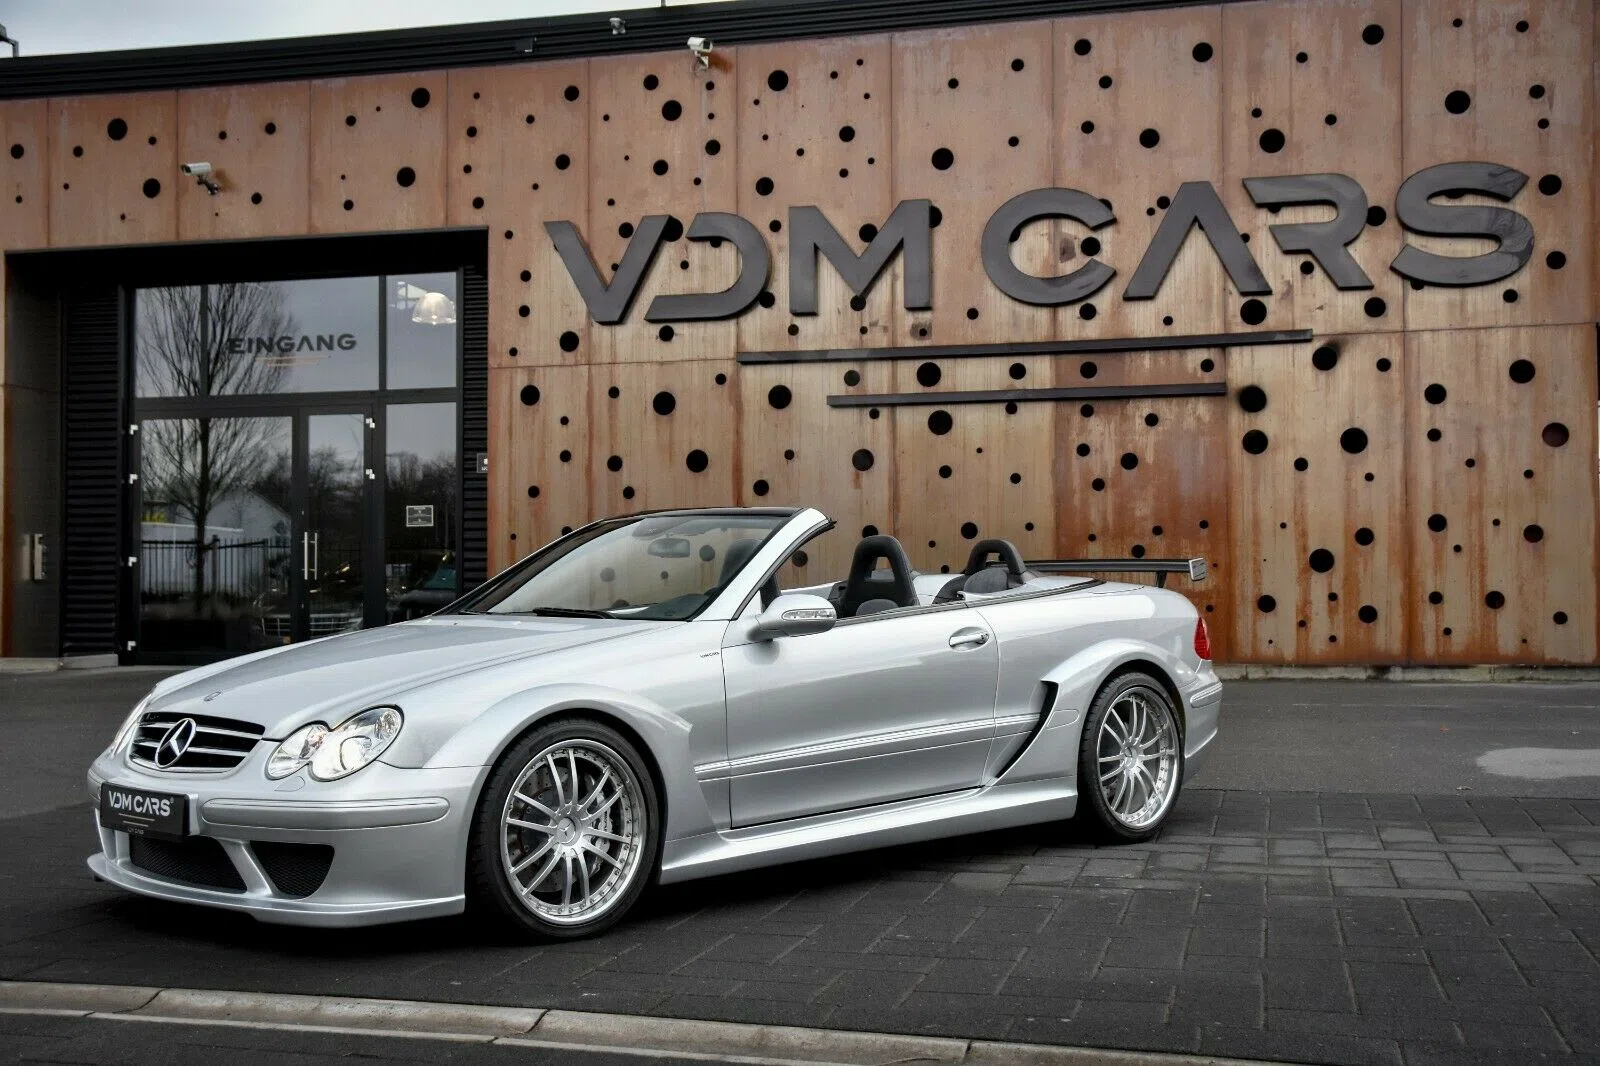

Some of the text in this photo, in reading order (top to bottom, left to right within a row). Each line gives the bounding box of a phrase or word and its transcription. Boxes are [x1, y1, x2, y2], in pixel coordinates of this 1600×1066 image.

[543, 161, 1535, 325] VDM CARS
[228, 333, 357, 354] EINGANG
[108, 790, 132, 811] VDM
